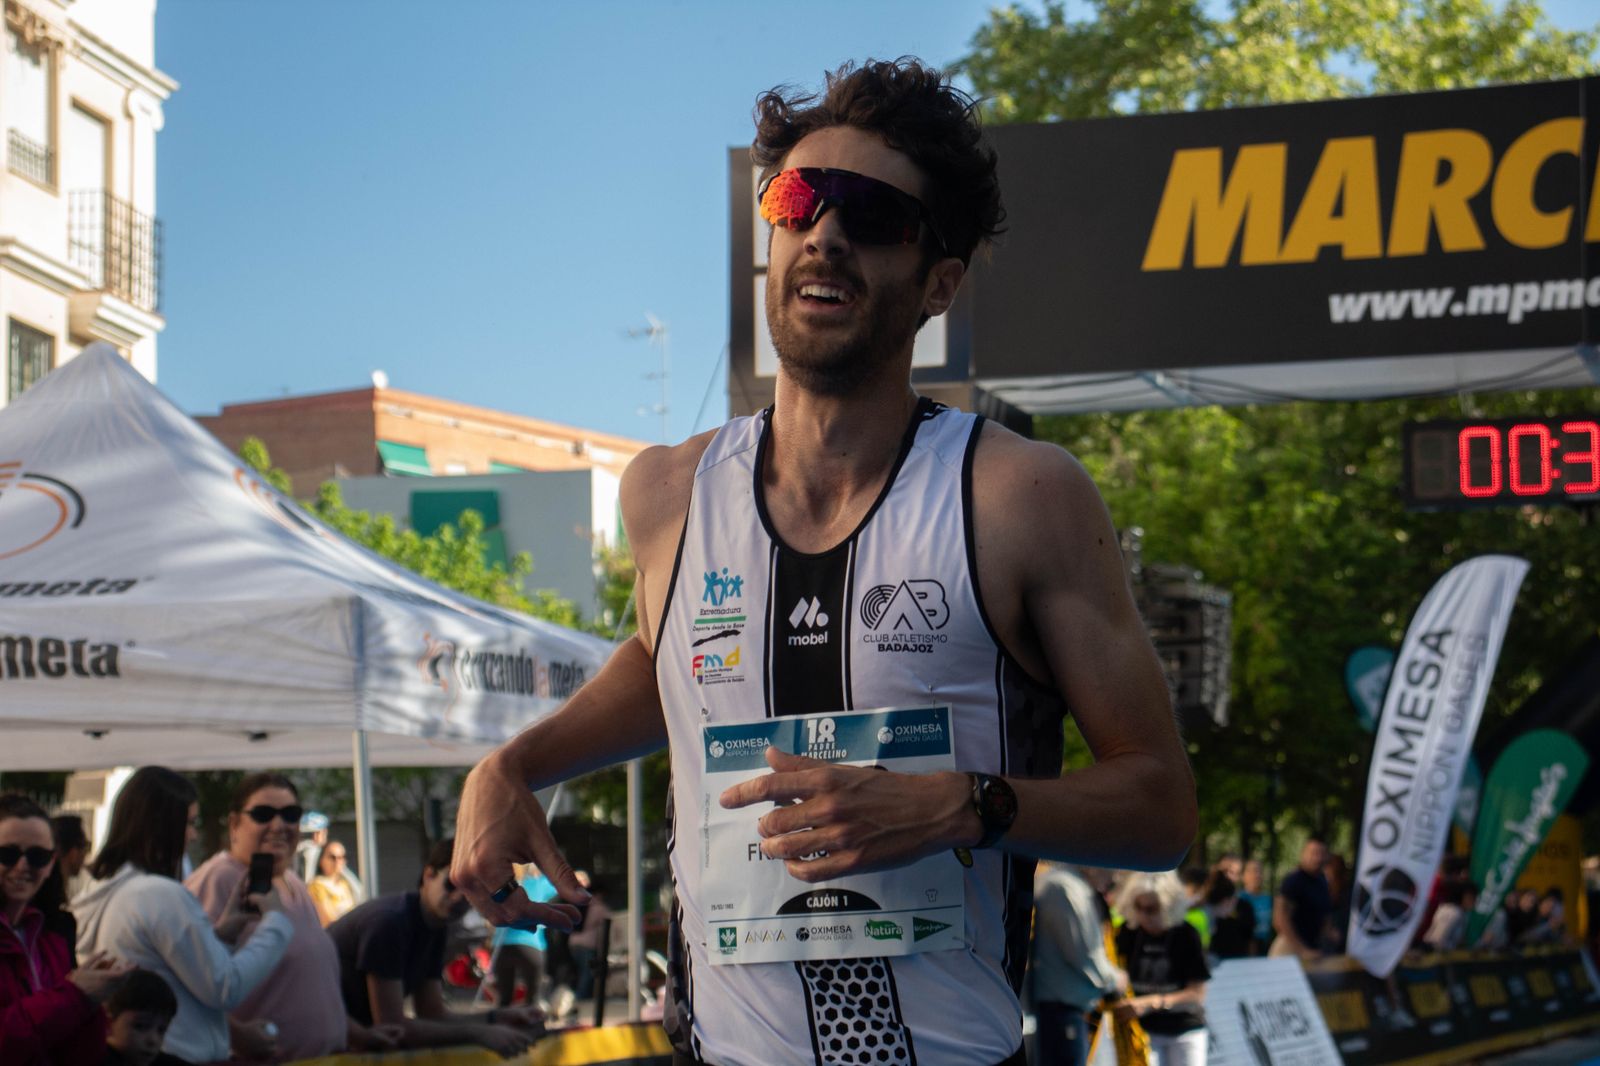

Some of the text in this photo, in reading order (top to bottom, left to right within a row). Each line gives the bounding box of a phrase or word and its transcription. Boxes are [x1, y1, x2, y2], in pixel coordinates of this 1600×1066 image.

[1141, 117, 1600, 272] MARC
[1458, 421, 1600, 497] 00:3
[699, 607, 741, 615] Extremadura
[788, 631, 828, 645] mobel
[863, 634, 947, 643] CLUB ATLETISMO
[878, 643, 933, 653] BADAJOZ
[0, 635, 120, 679] meta
[807, 718, 835, 743] 18
[895, 723, 942, 735] OXIMESA
[725, 737, 770, 749] OXIMESA
[1368, 627, 1452, 851] OXIMESA
[808, 742, 835, 751] PADRE
[1411, 746, 1458, 864] NIPPON
[1440, 633, 1486, 733] GASES
[806, 894, 848, 908] CAJÓN 1
[745, 929, 787, 944] ANAYA
[810, 925, 852, 934] OXIMESA
[865, 925, 902, 937] Natura
